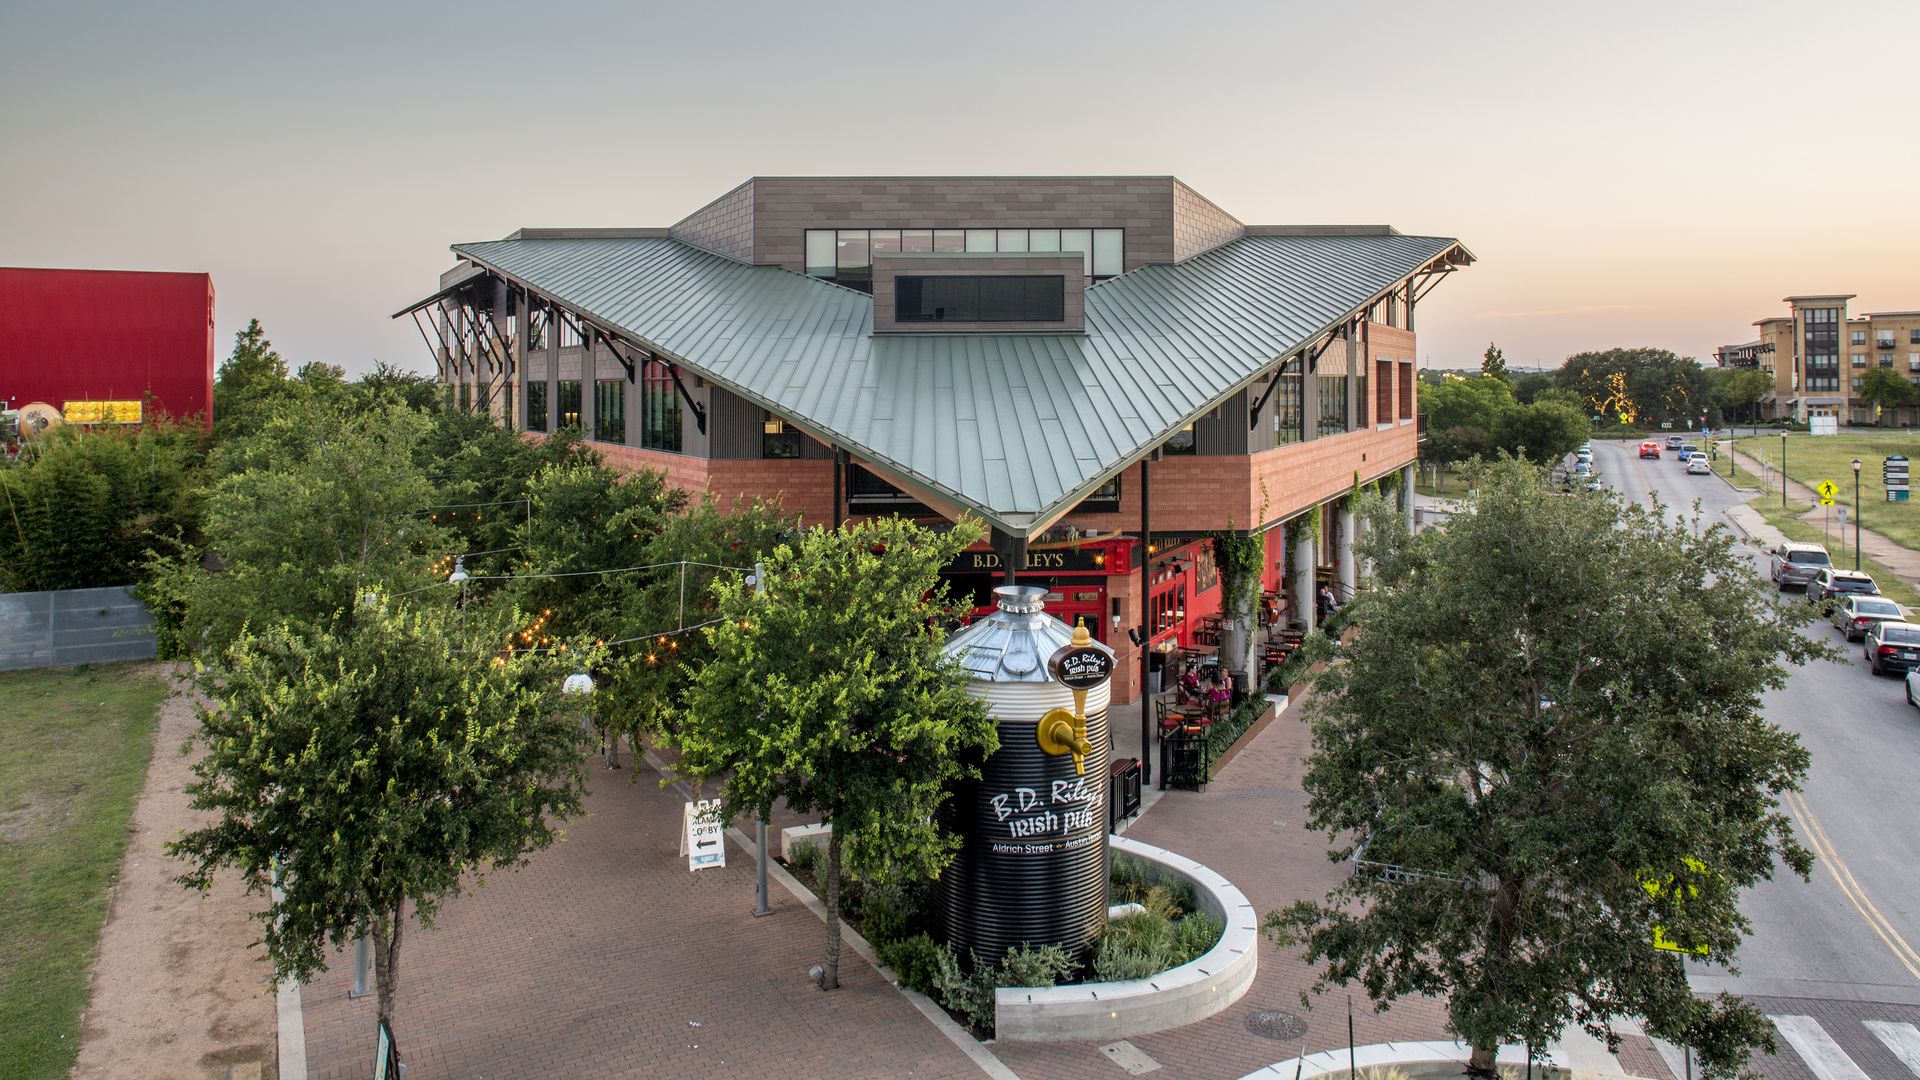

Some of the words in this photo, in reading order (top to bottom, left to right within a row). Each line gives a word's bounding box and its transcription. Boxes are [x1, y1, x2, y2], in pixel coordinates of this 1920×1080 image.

[973, 554, 1003, 568] B.D.
[1026, 553, 1065, 568] LEY'S
[1063, 657, 1081, 670] B.D.
[1082, 654, 1105, 666] Riley's
[990, 787, 1044, 821] B.D.
[1051, 778, 1104, 815] Riley's
[992, 843, 1023, 854] Aldrich
[1025, 844, 1054, 853] Street
[1065, 836, 1087, 849] Austin
